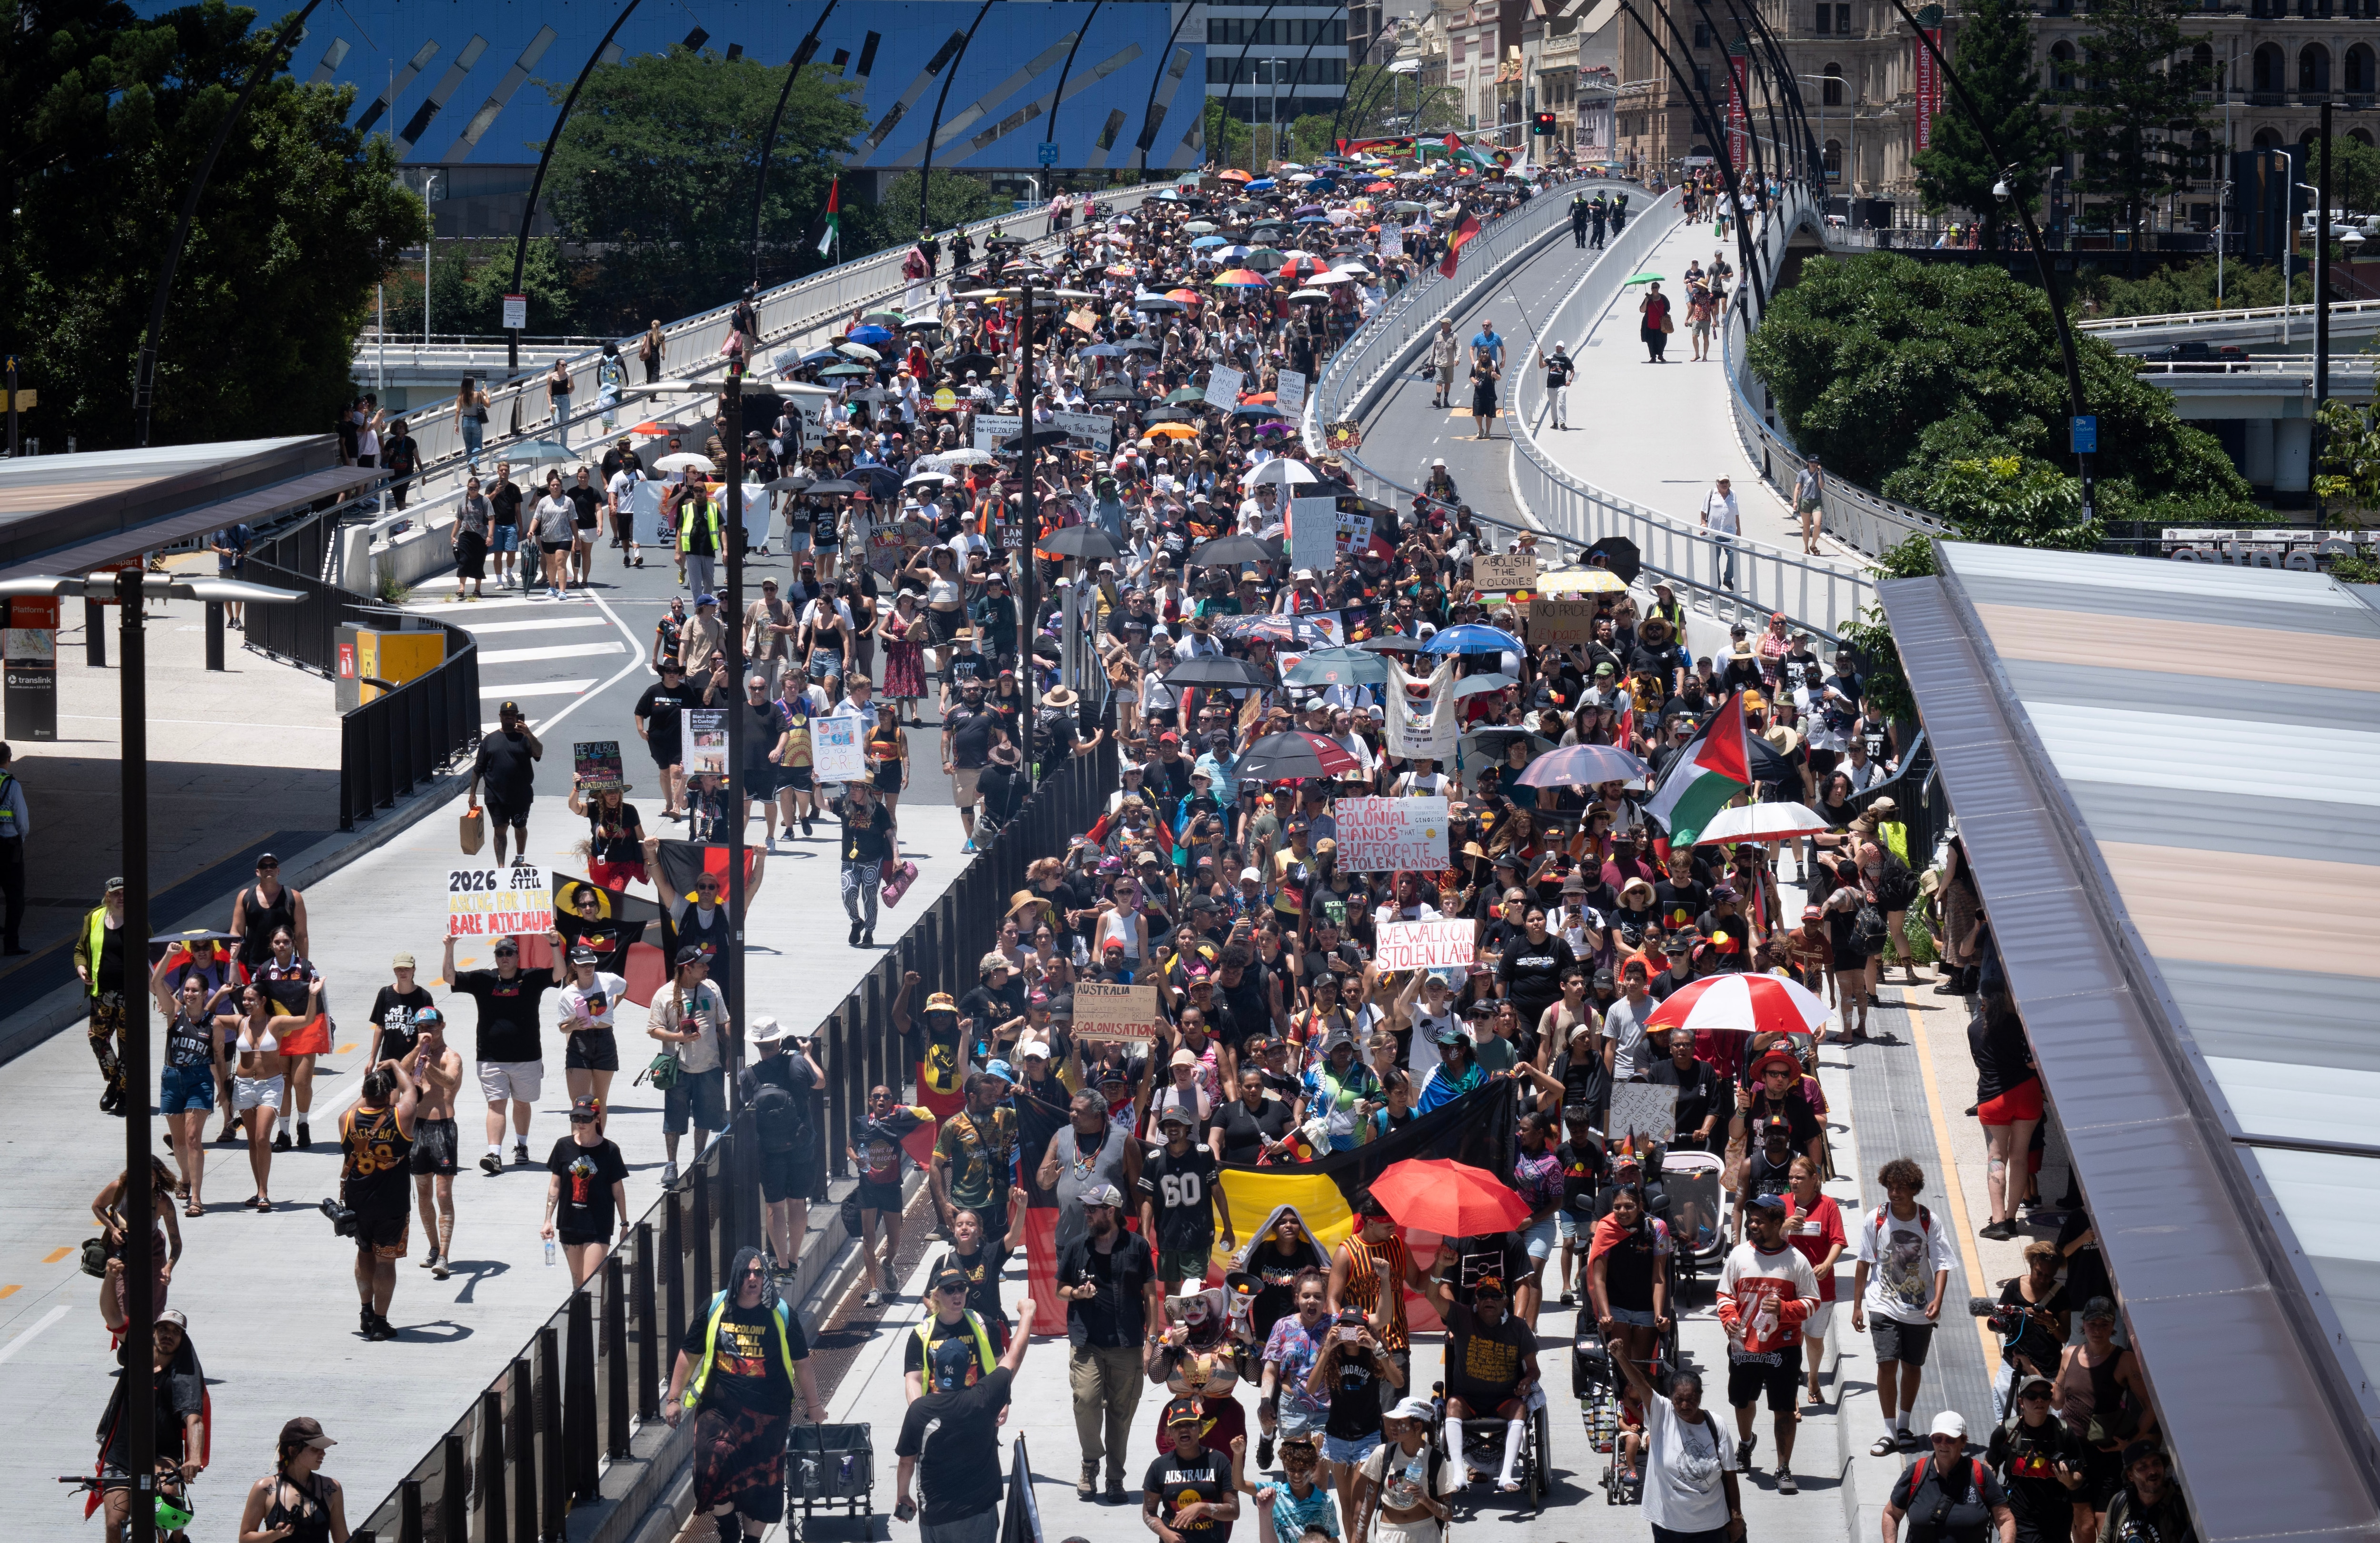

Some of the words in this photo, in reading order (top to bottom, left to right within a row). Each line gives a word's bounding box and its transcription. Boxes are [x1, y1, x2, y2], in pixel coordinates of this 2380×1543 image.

[779, 359, 803, 373] LANDBACK
[1216, 365, 1238, 380] THIS
[1211, 375, 1235, 389] LAND
[1280, 382, 1305, 390] AUSTRALIAN
[921, 392, 931, 400] They
[1218, 386, 1226, 395] IS
[1206, 389, 1235, 408] STOLEN
[804, 409, 817, 418] By
[1284, 405, 1301, 413] TELLING
[1074, 423, 1085, 432] This
[1087, 424, 1099, 433] Then
[1324, 423, 1338, 438] NO
[1338, 420, 1359, 433] PRIDE
[1297, 498, 1333, 517] STOP
[1354, 515, 1366, 525] WAS
[872, 526, 902, 537] STOLEN
[1003, 528, 1022, 538] LAN
[1341, 524, 1358, 534] WILL
[1359, 526, 1368, 536] BE
[877, 536, 902, 546] LAND
[1003, 538, 1022, 548] BAC
[1352, 546, 1368, 555] LAND
[1482, 557, 1531, 567] ABOLISH
[1480, 577, 1533, 587] COLONIES
[47, 608, 54, 624] 1
[1348, 609, 1369, 622] YOU'RE
[1537, 604, 1555, 617] NO
[1559, 604, 1588, 617] PRIDE
[1355, 620, 1365, 630] THE
[1534, 628, 1582, 640] GENOCIDE
[18, 676, 51, 684] translink
[575, 744, 591, 755] HEY
[1866, 742, 1881, 757] 93
[820, 753, 861, 770] CARE?
[581, 780, 622, 789] NATIONALLY!!!
[1336, 809, 1410, 827] COLONIAL
[1338, 826, 1399, 842] HANDS
[1338, 842, 1431, 860] SUFFOCATE
[1339, 857, 1397, 871] STOLEN
[1402, 856, 1450, 870] LANDS
[449, 870, 497, 892] 2026
[512, 868, 538, 878] AND
[510, 877, 542, 890] STILL
[449, 892, 493, 914] ASKING
[496, 891, 520, 912] FOR
[523, 889, 552, 910] THE
[450, 914, 483, 936] BARE
[488, 911, 553, 934] MINIMUM
[1379, 925, 1402, 945] WE
[1405, 925, 1450, 944] WALK
[1450, 922, 1474, 941] ON
[1378, 942, 1437, 971] STOLEN
[1442, 942, 1475, 965] LAND
[1077, 985, 1130, 995] AUSTRALIA
[389, 1005, 406, 1015] NOT
[1132, 1012, 1156, 1020] BRITISH
[385, 1013, 405, 1023] DATE
[404, 1013, 416, 1025] TO
[385, 1022, 416, 1036] CELEBRATE
[1076, 1021, 1155, 1037] COLONISATION
[171, 1037, 208, 1055] MURRI
[175, 1051, 194, 1065] 24
[1613, 1085, 1652, 1129] CONNECTION
[1614, 1090, 1639, 1115] OUR
[1646, 1103, 1661, 1118] OUR
[1648, 1103, 1671, 1140] SPIRIT
[967, 1149, 987, 1158] Deadly
[1161, 1172, 1201, 1207] 60
[721, 1322, 735, 1332] THE
[735, 1324, 766, 1335] COLONY
[737, 1334, 760, 1346] WILL
[930, 1340, 944, 1349] THE
[742, 1346, 764, 1357] FALL
[2007, 1429, 2018, 1443] Canon
[1164, 1468, 1215, 1483] AUSTRALIA
